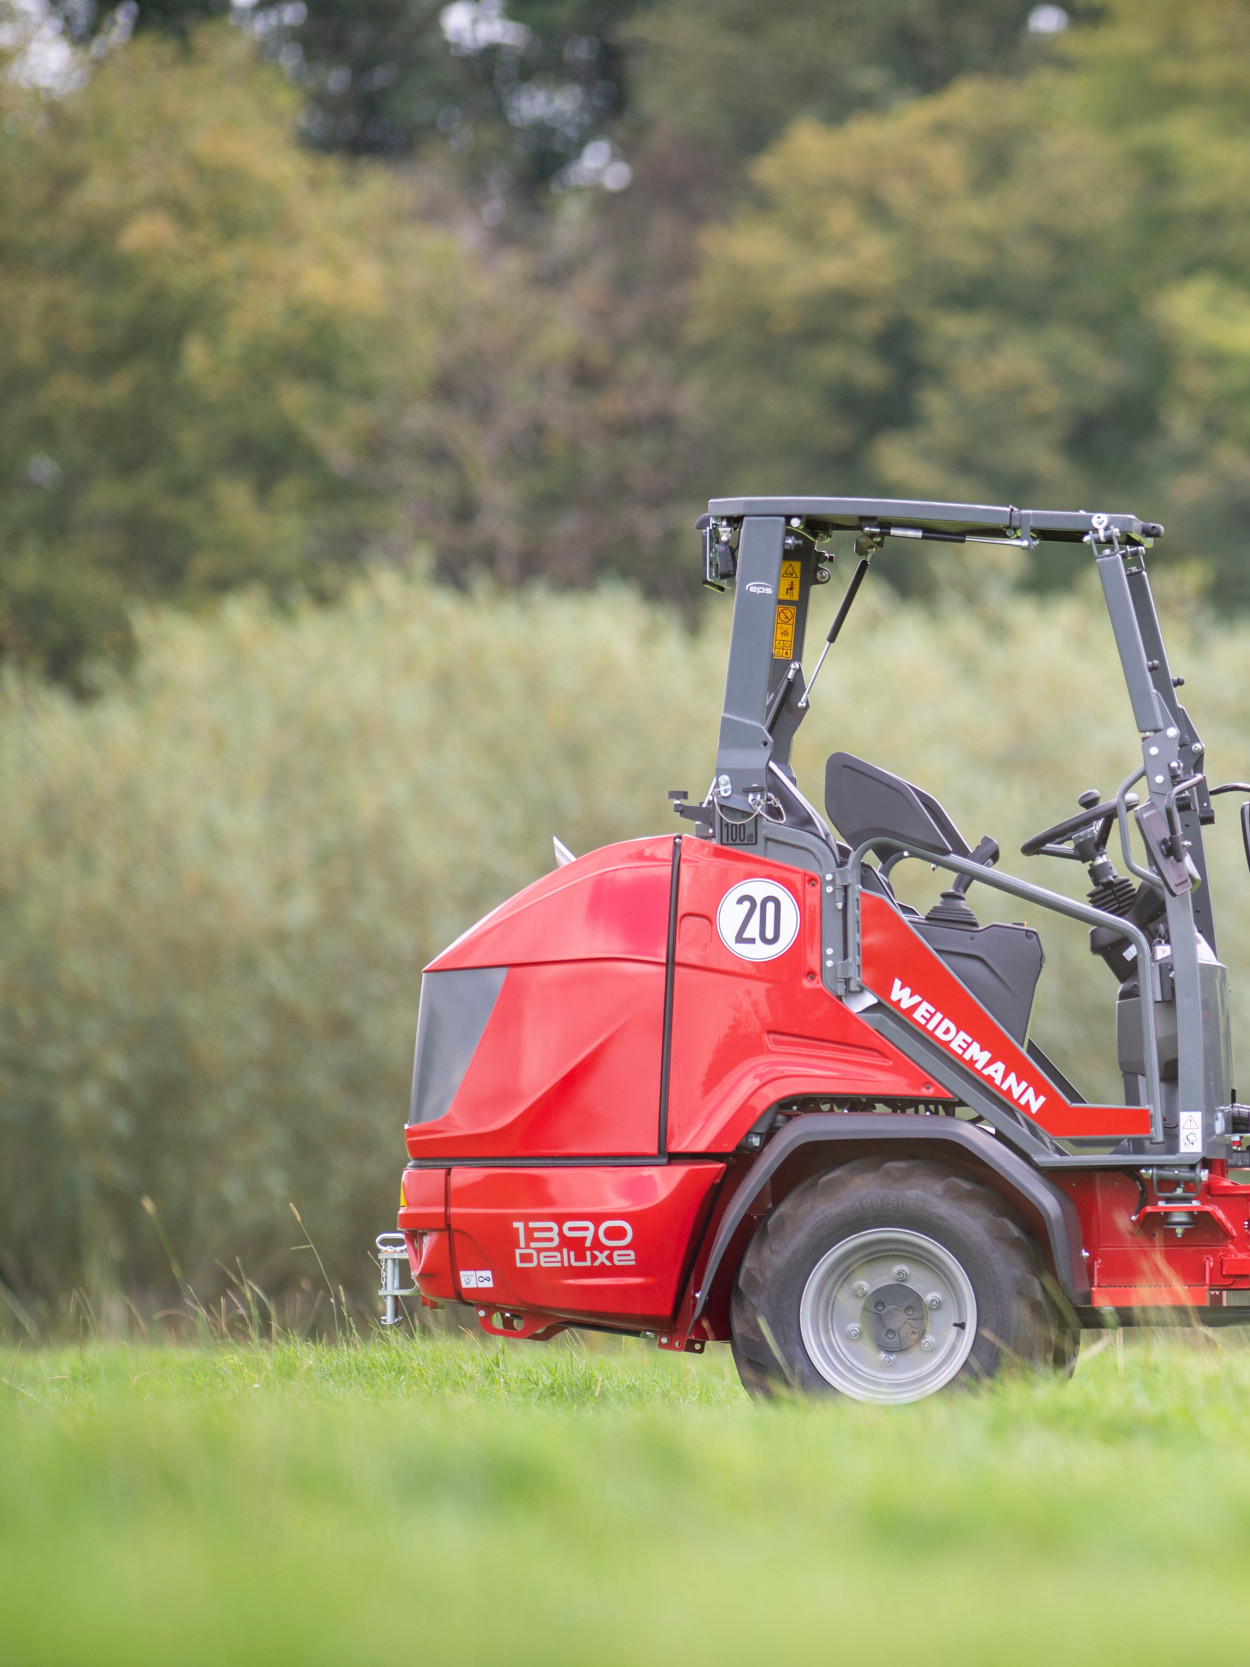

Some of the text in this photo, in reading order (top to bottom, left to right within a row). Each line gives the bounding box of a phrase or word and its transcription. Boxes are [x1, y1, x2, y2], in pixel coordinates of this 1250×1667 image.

[748, 584, 773, 595] eps
[724, 822, 746, 843] 100
[735, 894, 782, 946] 20
[890, 977, 1047, 1115] WEIDEMANN
[512, 1220, 633, 1248] 1390
[515, 1248, 636, 1268] Deluxe
